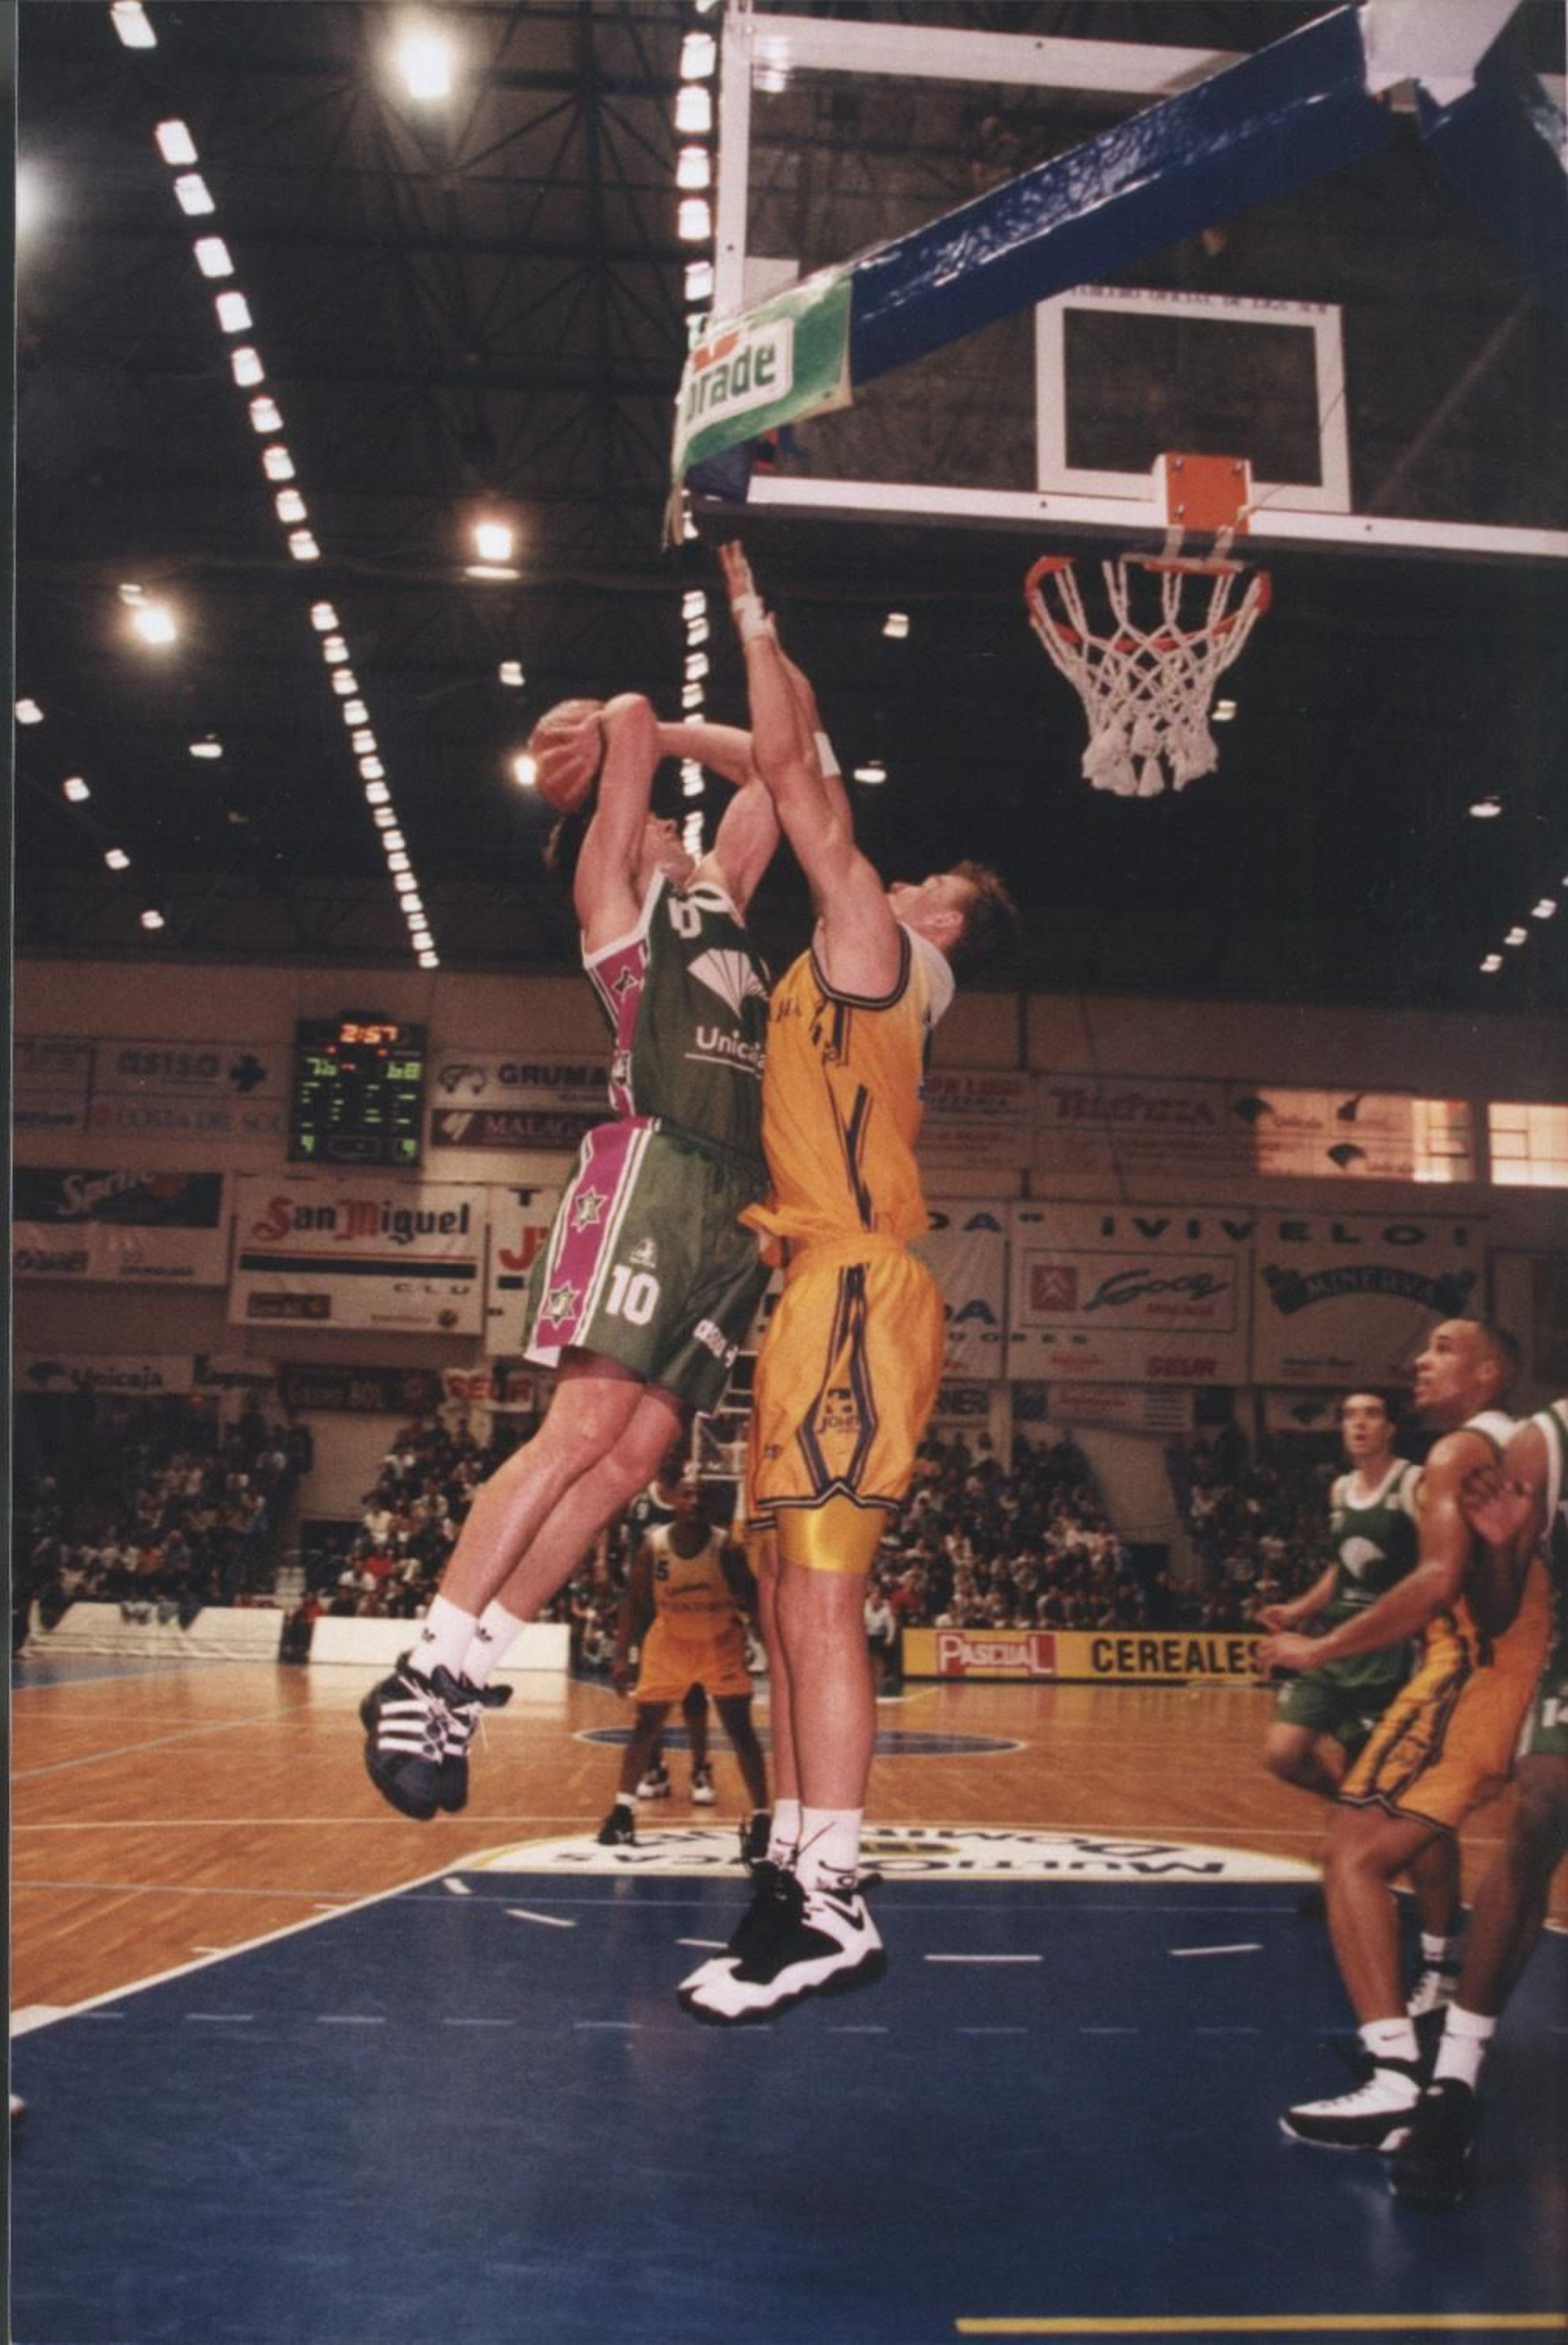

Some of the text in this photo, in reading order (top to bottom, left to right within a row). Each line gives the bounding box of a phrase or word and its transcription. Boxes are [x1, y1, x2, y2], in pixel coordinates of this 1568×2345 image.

[341, 1023, 398, 1045] 2:57
[251, 1197, 469, 1245] San Miguel
[604, 1263, 661, 1327] 10
[939, 1635, 1054, 1675] PASCUAL
